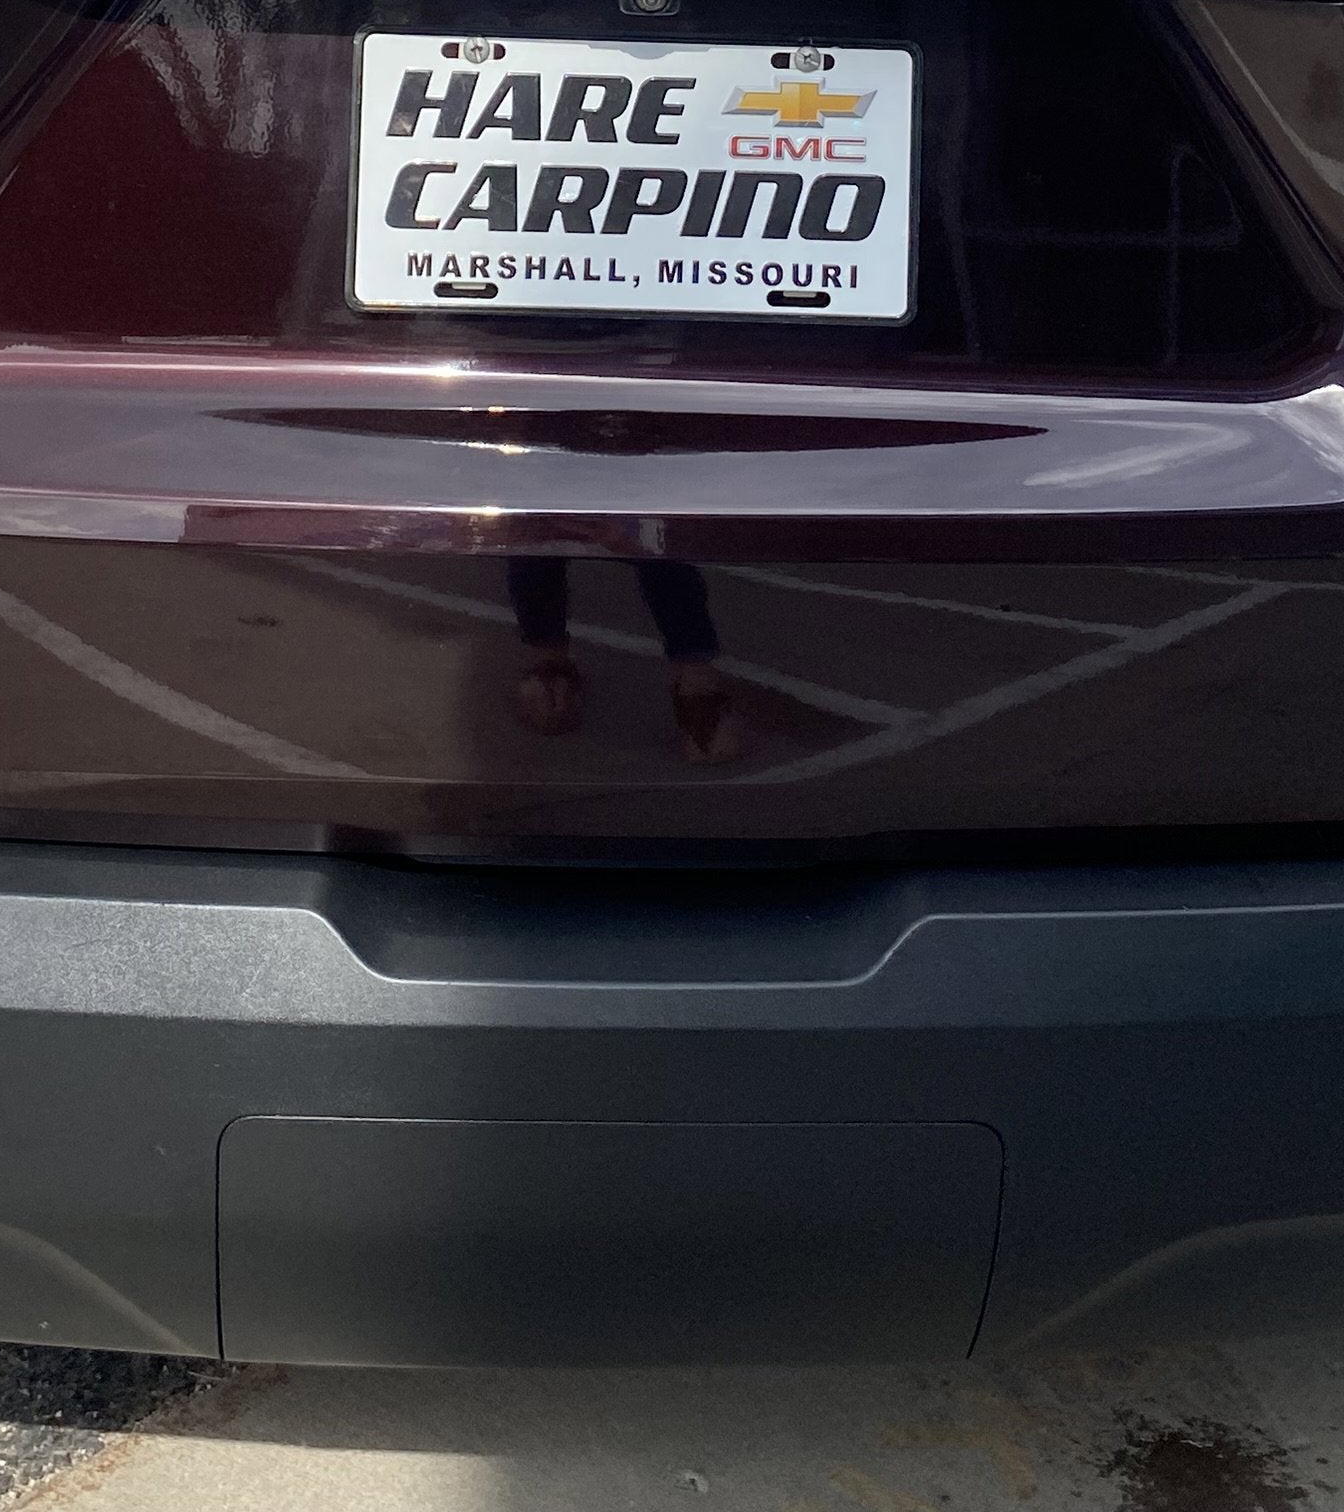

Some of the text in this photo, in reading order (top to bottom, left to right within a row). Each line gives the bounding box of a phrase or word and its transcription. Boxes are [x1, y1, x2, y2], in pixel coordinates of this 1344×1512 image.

[385, 69, 697, 145] HARE
[727, 133, 867, 163] GMC
[384, 161, 887, 242] CARPINO
[406, 251, 859, 289] MARSHALL, MISSOURI
